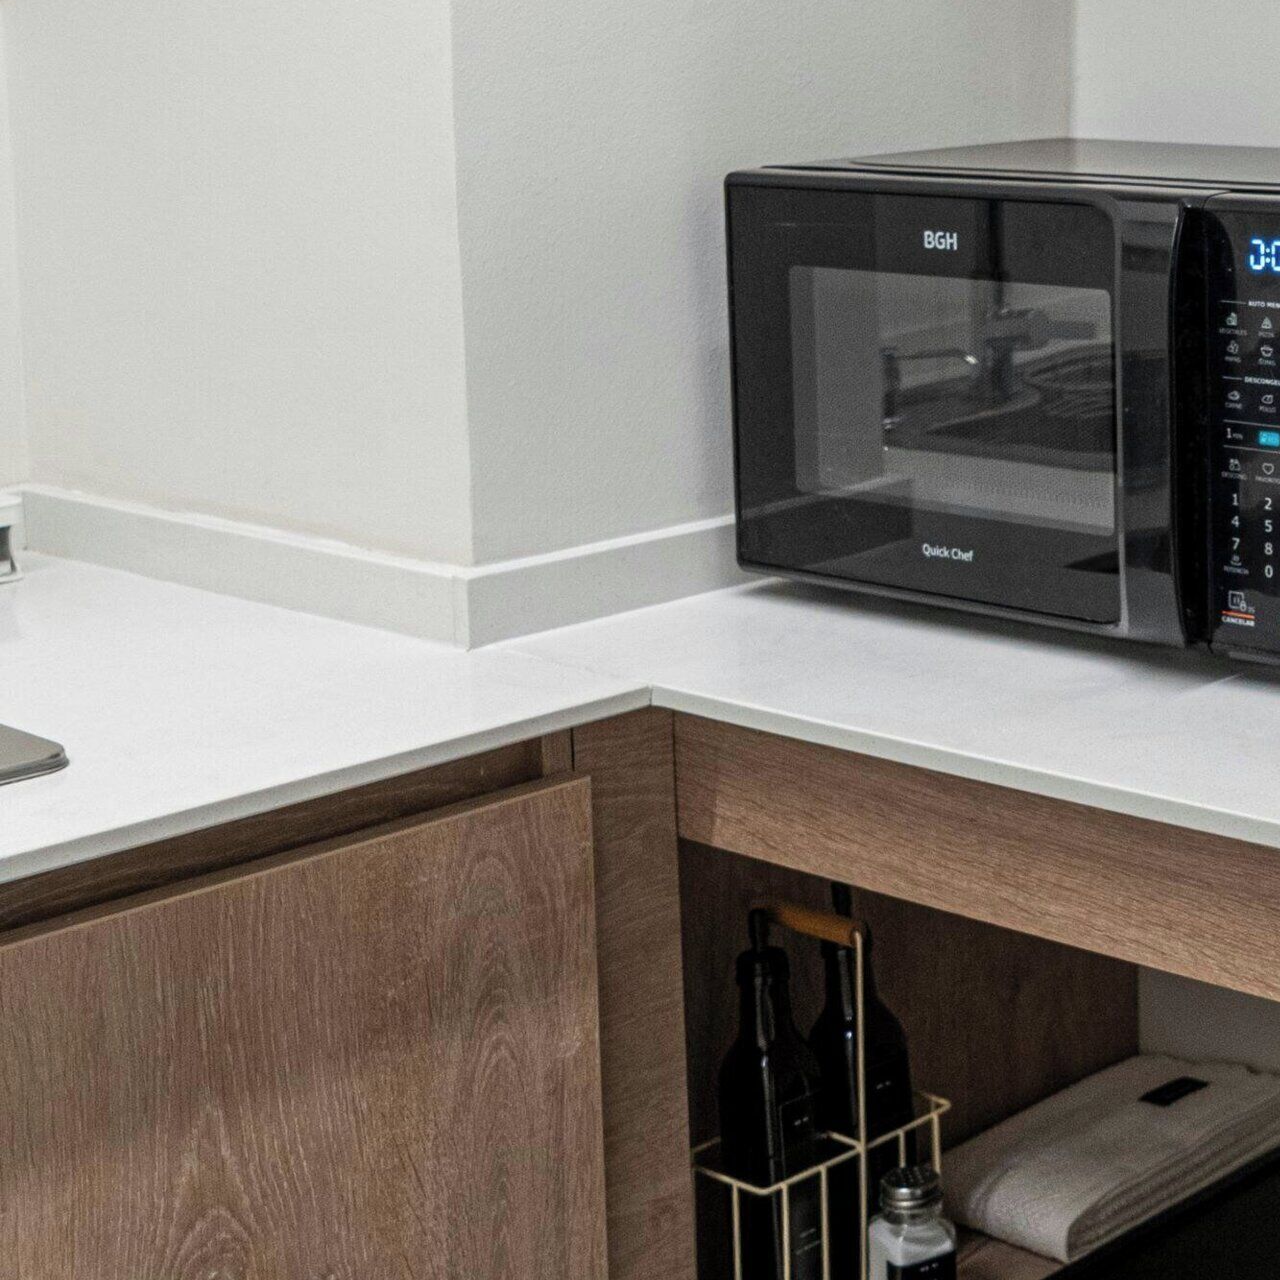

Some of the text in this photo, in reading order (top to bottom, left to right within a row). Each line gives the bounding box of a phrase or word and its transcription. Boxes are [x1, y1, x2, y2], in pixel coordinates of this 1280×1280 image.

[923, 230, 958, 251] BGH
[1232, 493, 1239, 506] 1
[1264, 497, 1272, 511] 2
[1231, 515, 1240, 528] 4
[1264, 520, 1273, 533] 5
[1231, 537, 1241, 550] 7
[1264, 542, 1273, 556] 8
[921, 543, 974, 562] Quick Chef
[1264, 564, 1274, 579] 0
[1221, 615, 1256, 628] CANCELAR
